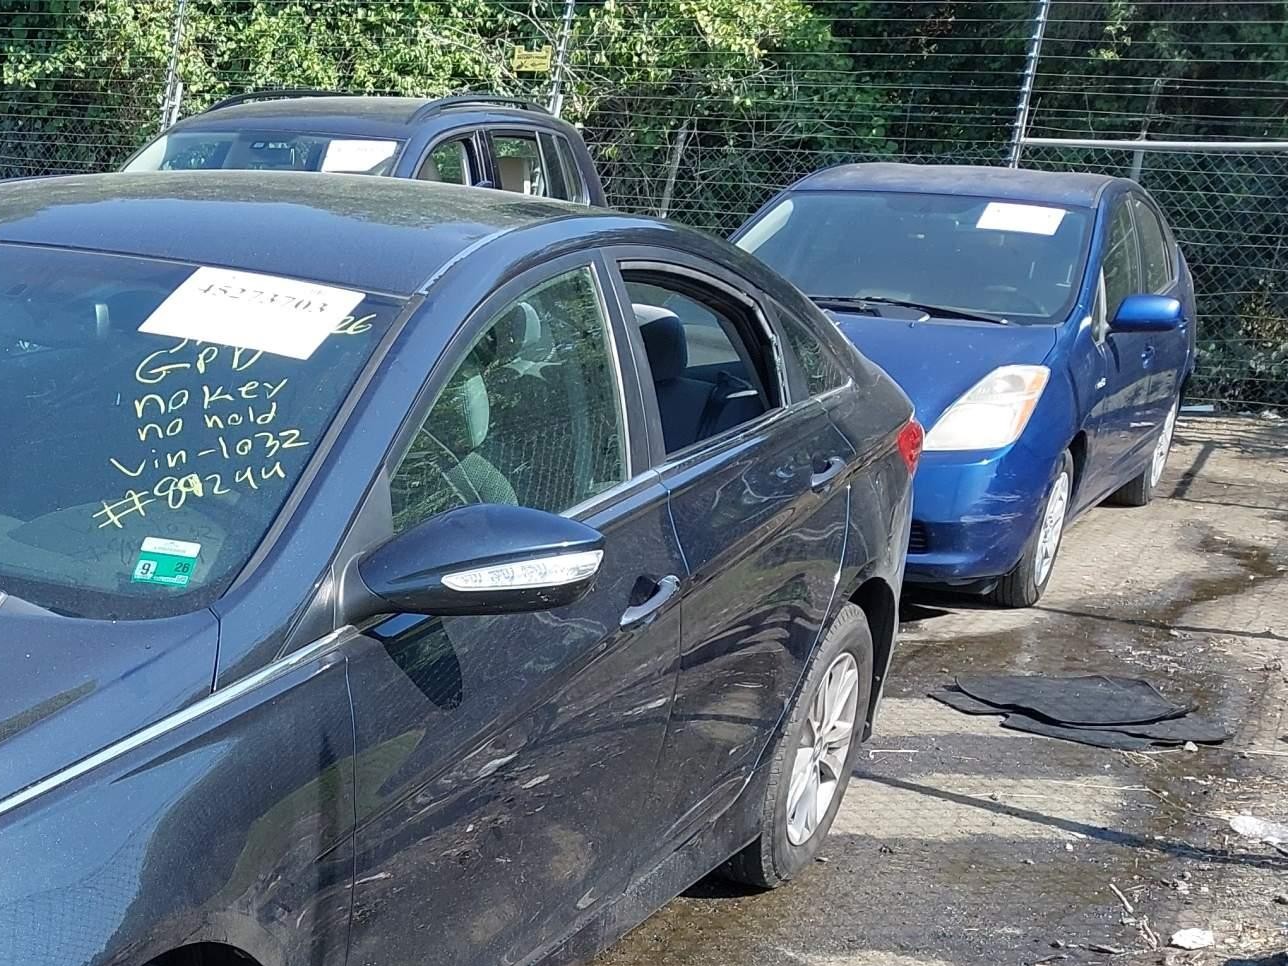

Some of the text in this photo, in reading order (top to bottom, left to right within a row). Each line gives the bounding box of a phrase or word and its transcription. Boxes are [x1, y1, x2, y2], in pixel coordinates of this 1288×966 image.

[197, 283, 331, 314] 45273703
[134, 390, 189, 419] no
[137, 418, 183, 442] no
[174, 562, 191, 573] 26
